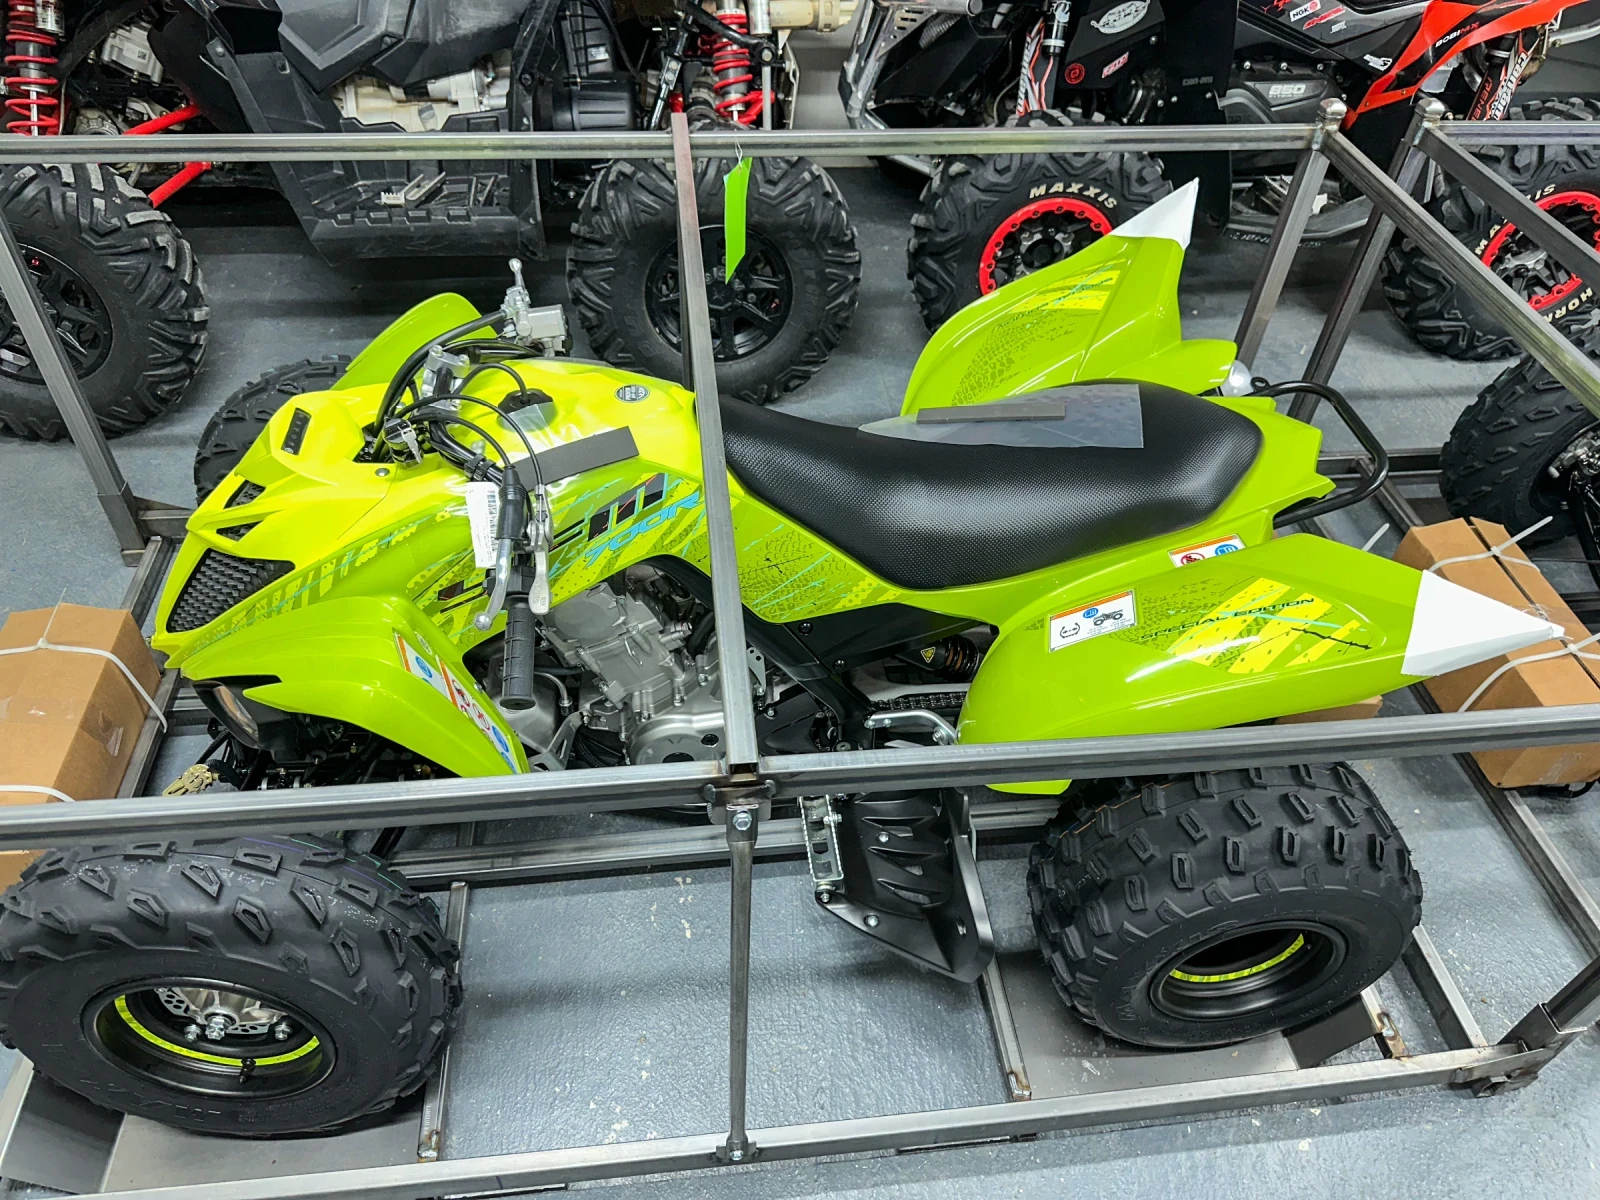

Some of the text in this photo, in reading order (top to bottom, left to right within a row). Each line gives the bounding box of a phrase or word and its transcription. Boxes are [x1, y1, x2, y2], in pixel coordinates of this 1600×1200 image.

[1292, 7, 1311, 19] NGK
[1268, 83, 1306, 95] 850
[1029, 182, 1117, 209] MAXXIS
[585, 490, 700, 568] 700R
[1139, 616, 1228, 641] SPECIAL
[1233, 597, 1315, 618] EDITION
